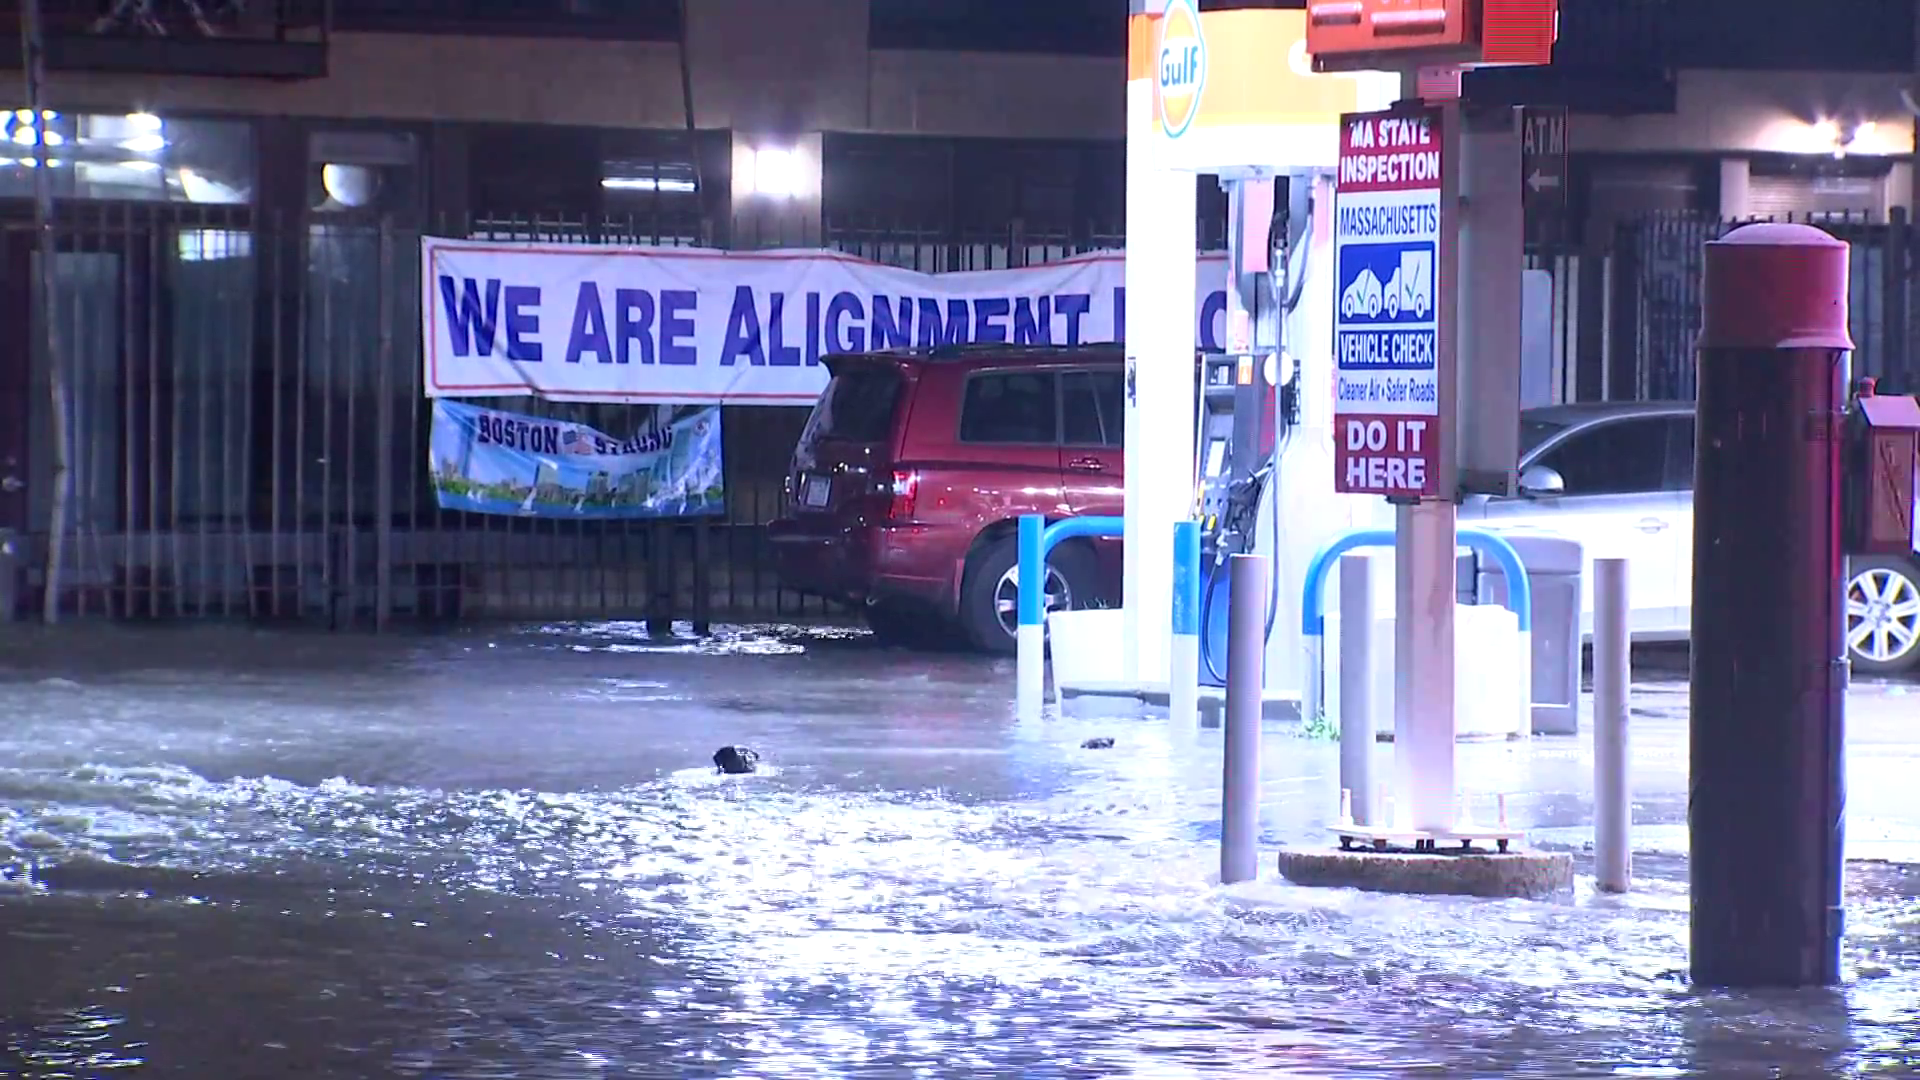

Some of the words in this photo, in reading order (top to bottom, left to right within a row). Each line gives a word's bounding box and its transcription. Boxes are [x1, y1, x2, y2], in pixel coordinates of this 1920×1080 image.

[1161, 45, 1198, 87] Gulf
[1350, 120, 1375, 148] MA
[1378, 116, 1431, 147] STATE
[1523, 116, 1563, 155] ATM
[1341, 151, 1440, 184] INSPECTION
[1340, 203, 1437, 236] MASSACHUSETTS
[440, 276, 542, 362] WE
[565, 281, 697, 365] ARE
[720, 285, 1090, 367] ALIGNMENT
[1340, 334, 1389, 363] VEHICLE
[1392, 333, 1433, 363] CHECK
[1338, 376, 1368, 401] Cleaner
[1386, 376, 1408, 402] Safer
[1409, 377, 1435, 402] Roads
[477, 414, 560, 454] BOSTON
[1347, 420, 1387, 451] DO
[1397, 421, 1427, 452] IT
[1347, 457, 1426, 489] HERE
